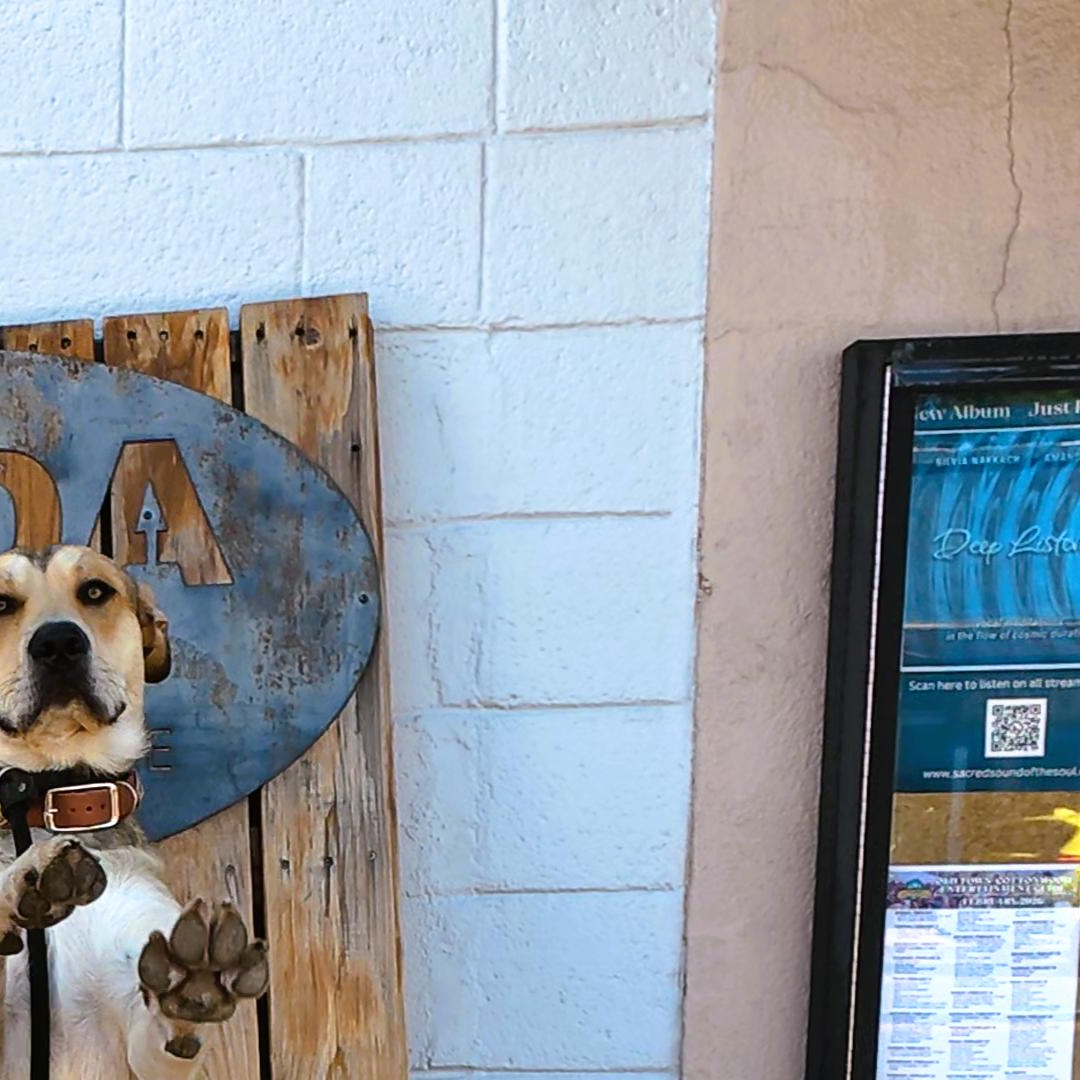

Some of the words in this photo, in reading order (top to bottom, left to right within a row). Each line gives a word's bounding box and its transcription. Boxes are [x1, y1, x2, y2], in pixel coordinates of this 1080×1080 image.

[951, 404, 1011, 420] Album
[1028, 401, 1071, 417] Just
[1008, 524, 1080, 558] Liste
[908, 679, 936, 692] Scan
[937, 680, 963, 691] here
[965, 680, 978, 691] to
[979, 679, 1011, 690] listen
[1012, 679, 1027, 689] on
[1029, 678, 1042, 689] all
[923, 766, 1080, 779] www.sacredsoundofthesoul.
